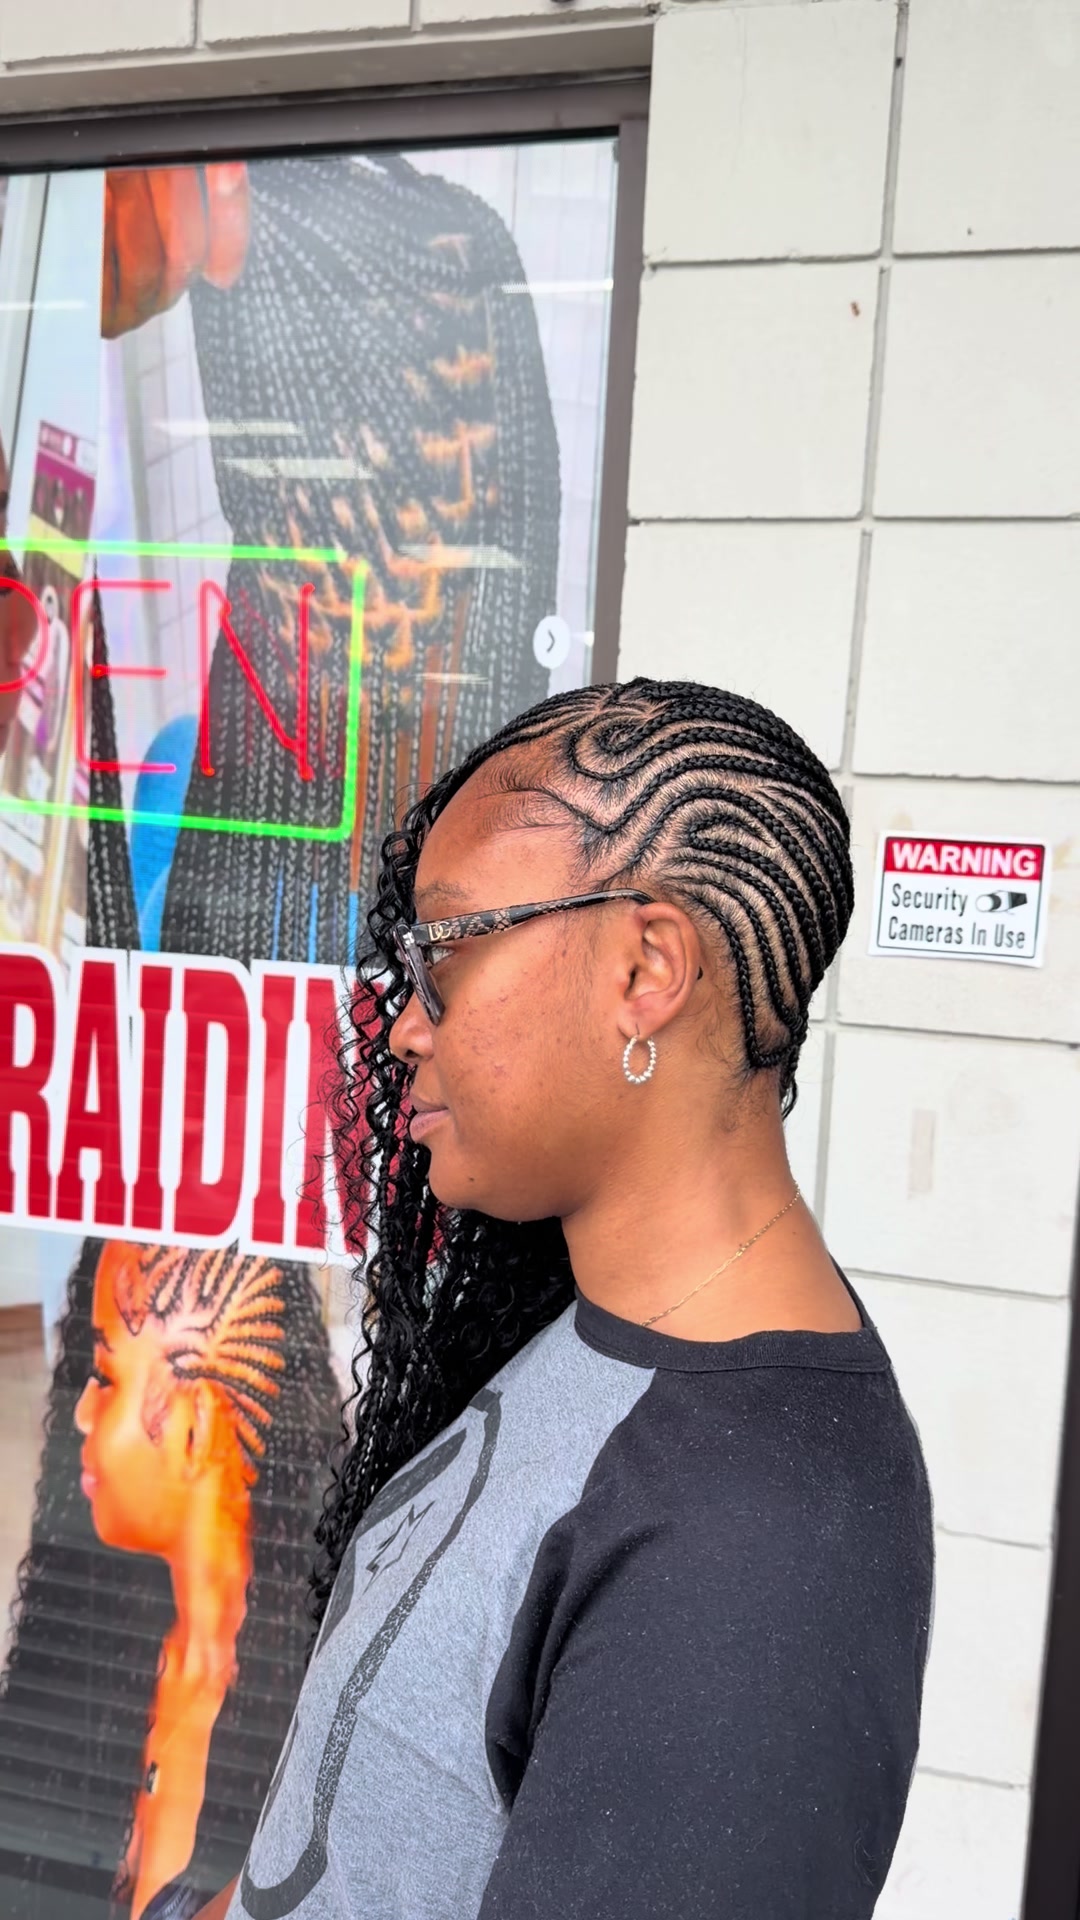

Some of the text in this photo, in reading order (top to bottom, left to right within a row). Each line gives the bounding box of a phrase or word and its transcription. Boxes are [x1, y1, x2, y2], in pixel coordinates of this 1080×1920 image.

[892, 842, 1036, 877] WARNING
[891, 883, 968, 917] Security
[427, 921, 452, 942] DG
[888, 916, 1025, 949] Cameras In Use
[0, 953, 395, 1258] RAIDIN
